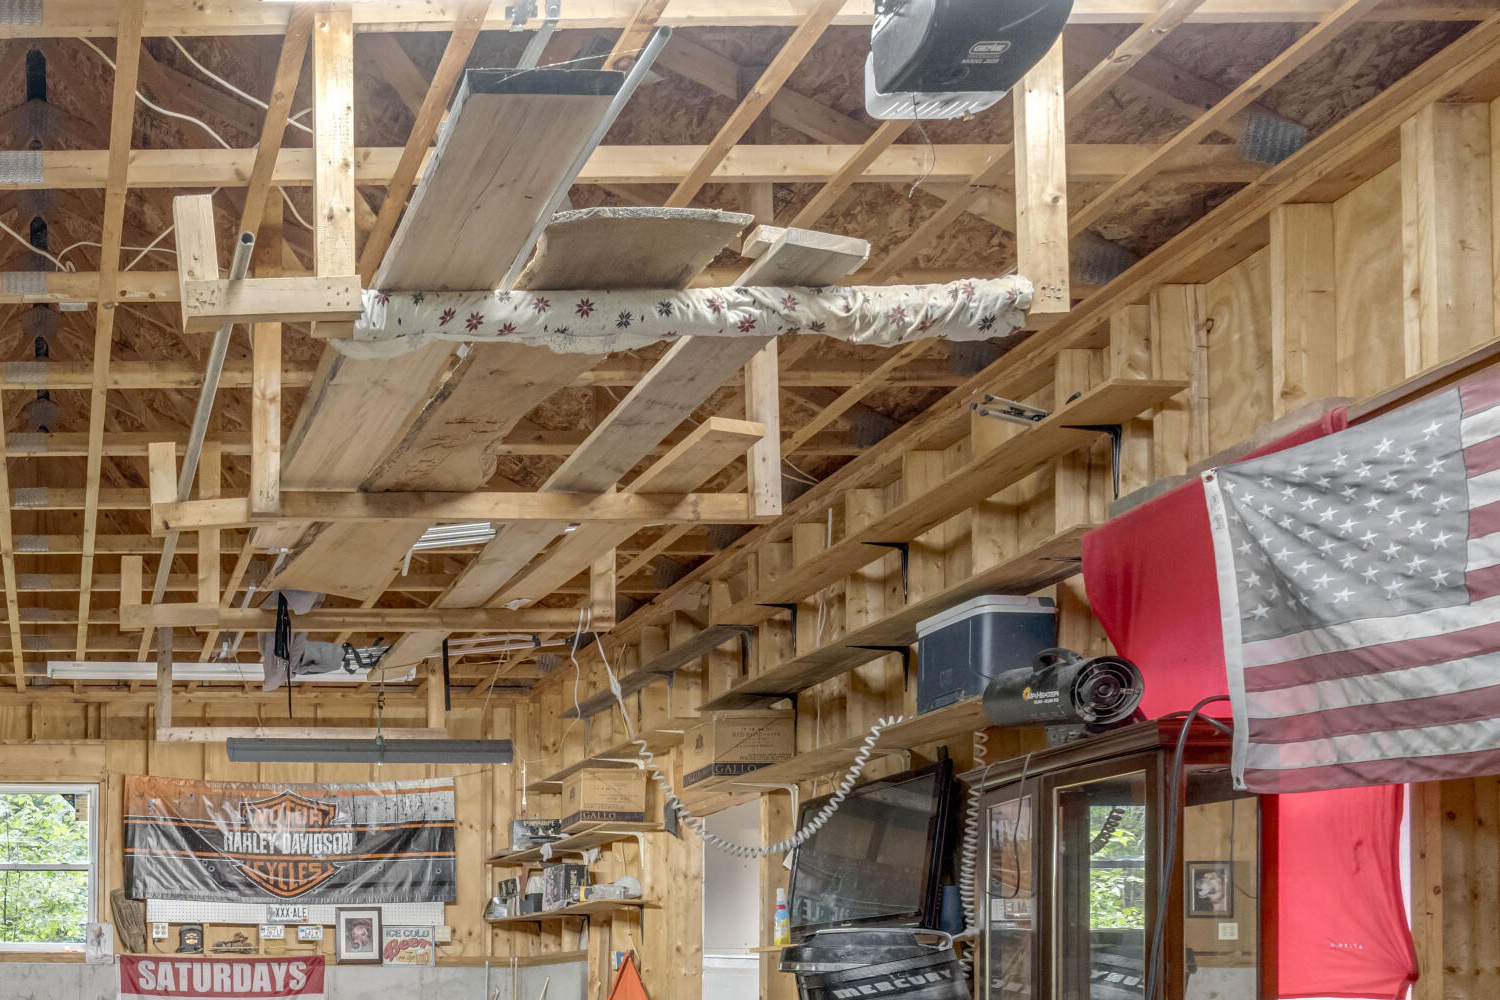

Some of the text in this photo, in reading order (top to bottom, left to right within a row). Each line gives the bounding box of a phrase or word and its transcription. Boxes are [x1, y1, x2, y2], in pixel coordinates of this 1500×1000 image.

[715, 763, 757, 774] GALLO
[582, 811, 617, 820] GALLO
[254, 861, 322, 890] CYCLES
[386, 928, 430, 938] ICE COLD
[137, 960, 308, 993] SATURDAYS
[832, 968, 952, 999] MERCURY
